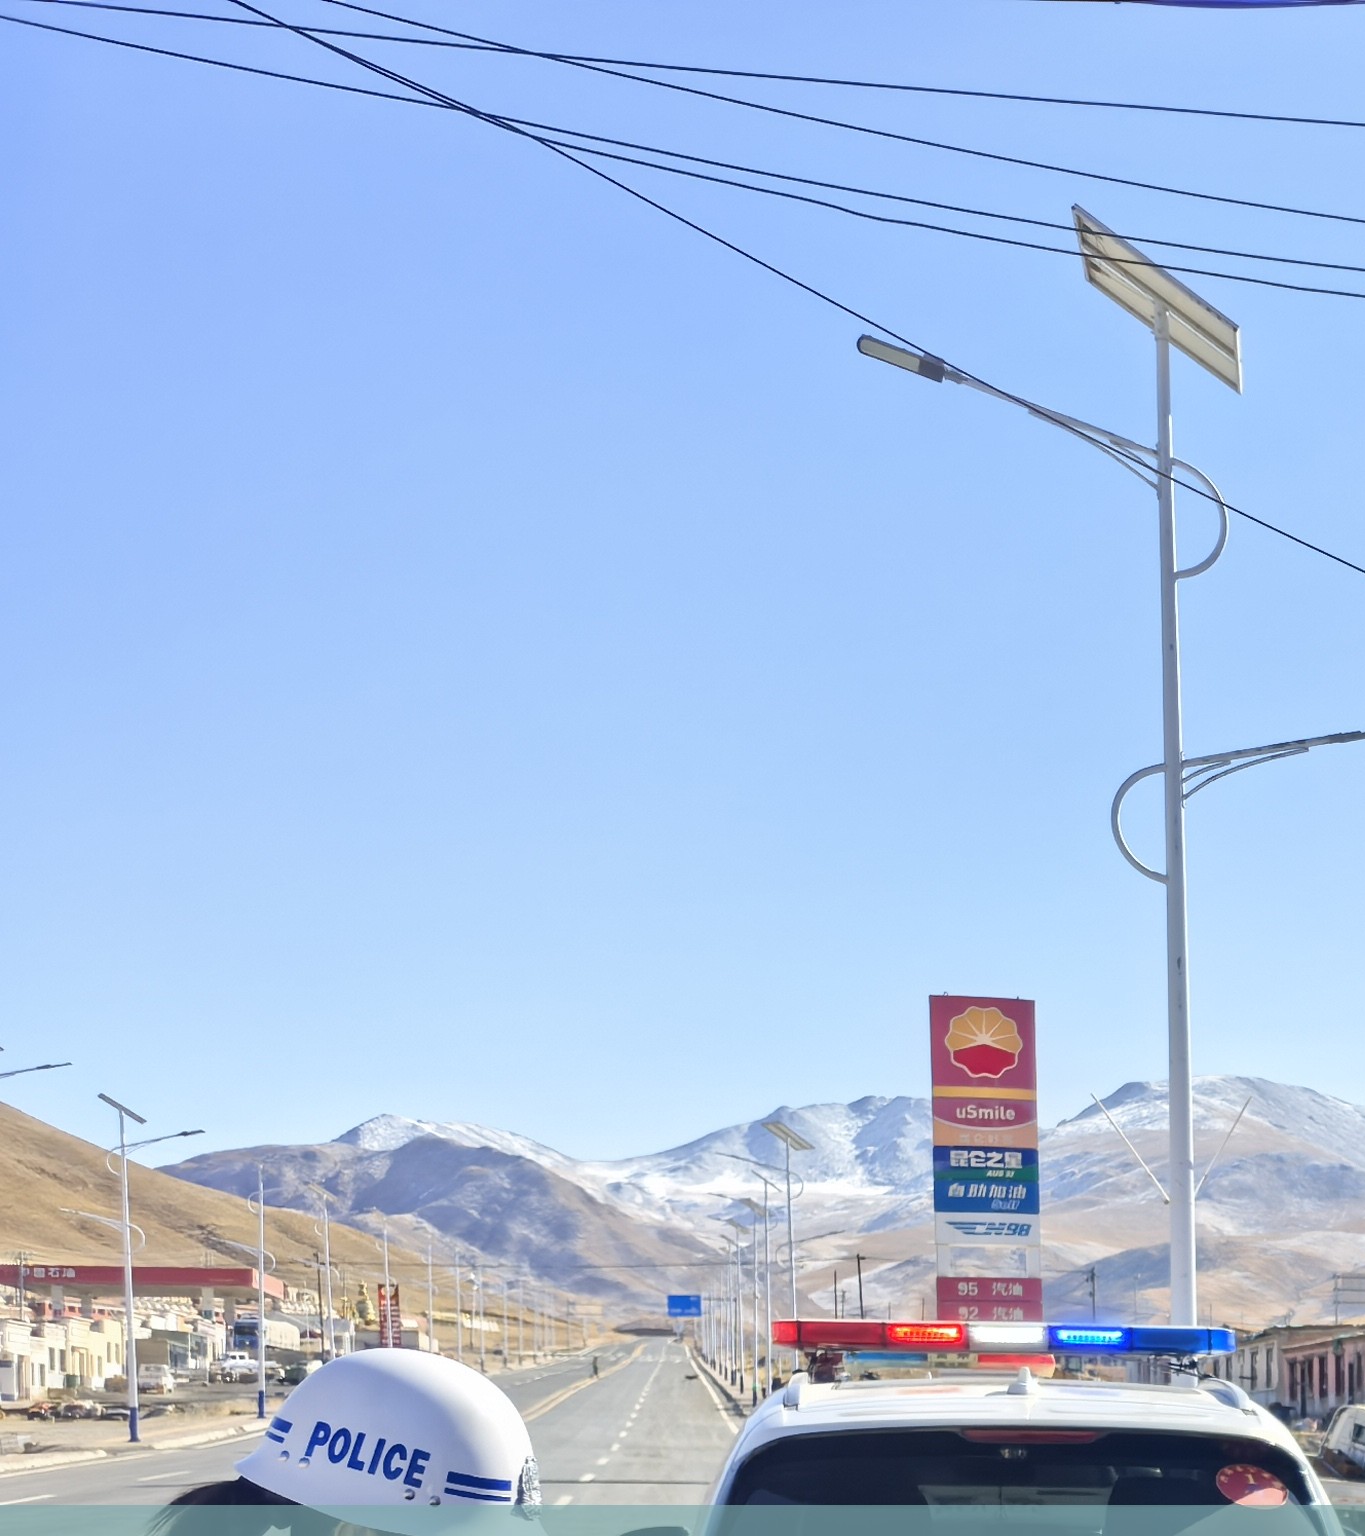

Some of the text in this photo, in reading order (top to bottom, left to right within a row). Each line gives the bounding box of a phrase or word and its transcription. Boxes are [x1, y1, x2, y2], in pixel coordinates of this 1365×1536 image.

[956, 1104, 1016, 1121] uSmile
[950, 1150, 1022, 1168] 昆仑之星
[958, 1282, 1023, 1297] 95 汽油
[959, 1306, 979, 1320] 92
[304, 1421, 431, 1488] POLICE
